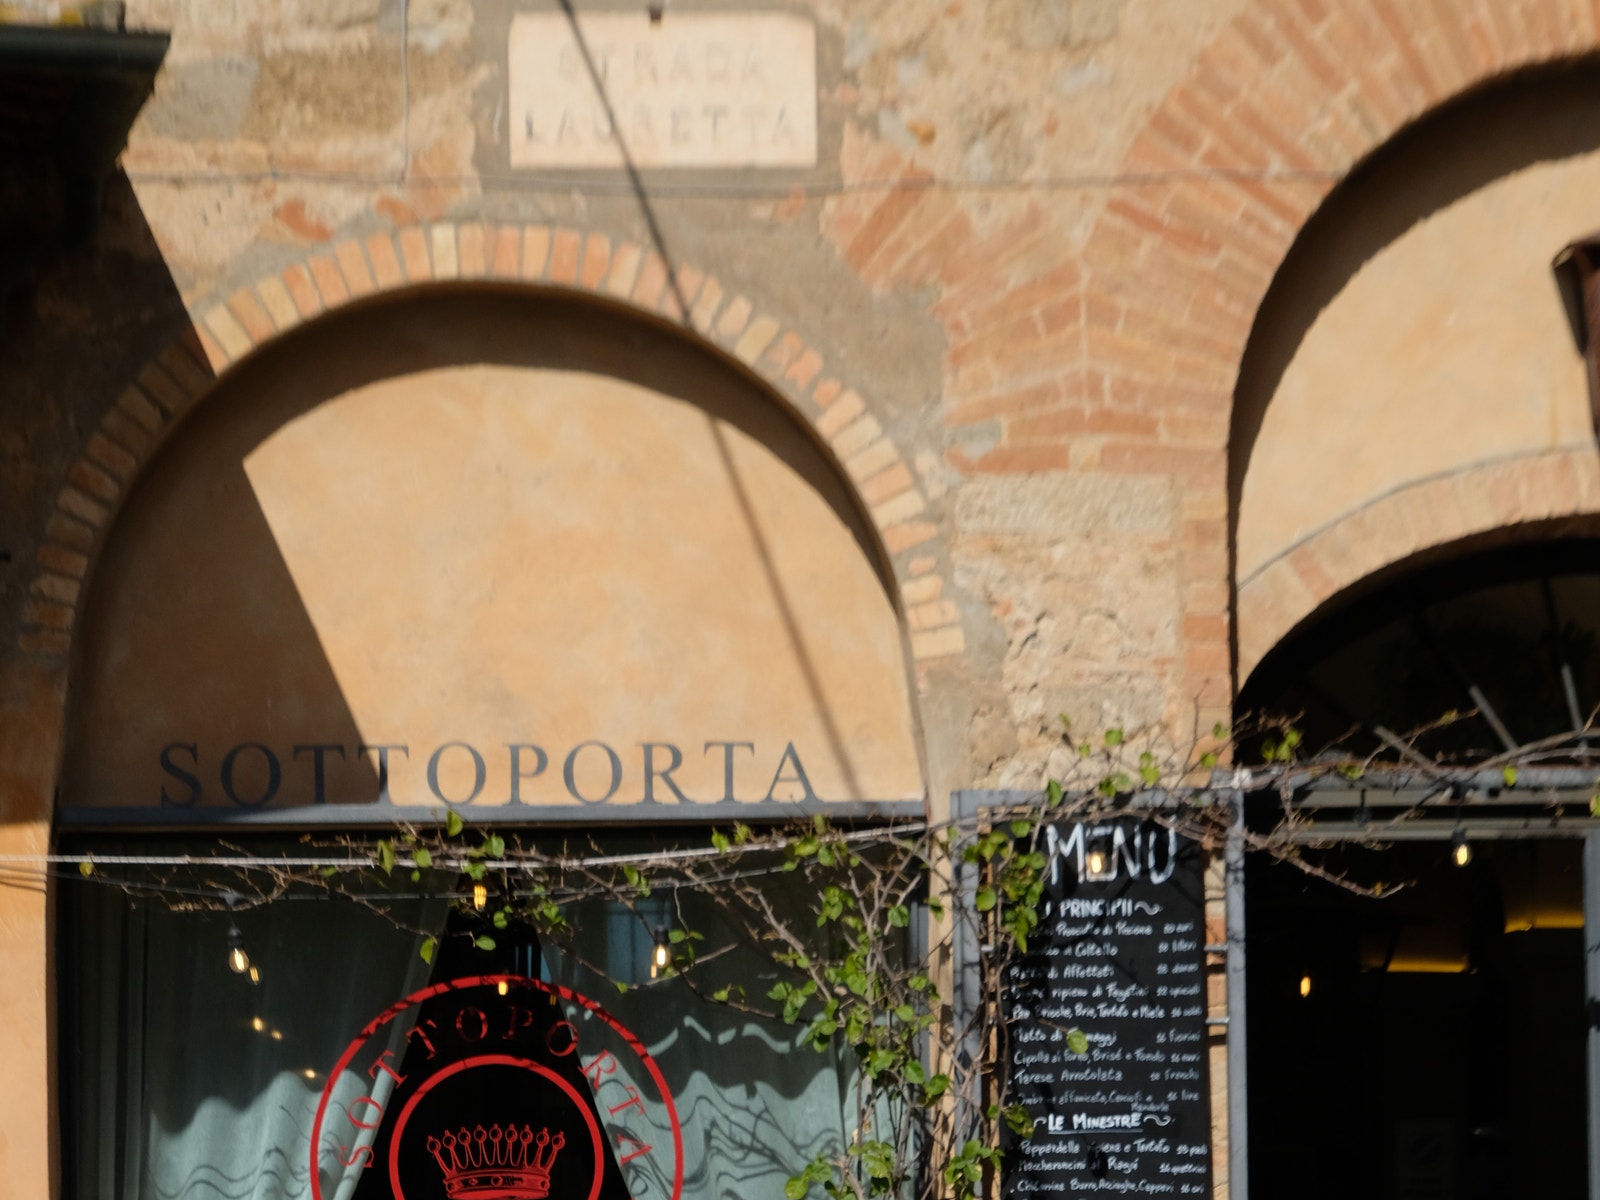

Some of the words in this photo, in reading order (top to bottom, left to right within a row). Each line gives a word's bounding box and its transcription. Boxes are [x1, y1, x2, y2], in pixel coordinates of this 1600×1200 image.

[161, 741, 819, 806] SOTTOPORTA
[1060, 898, 1133, 918] PRINCIPII
[1047, 966, 1058, 979] di
[1092, 984, 1103, 998] di
[1050, 1027, 1063, 1042] di
[1060, 1067, 1124, 1082] Arrotolata
[339, 1004, 654, 1168] SOTTOPORTA
[1048, 1113, 1065, 1131] LE
[1072, 1111, 1143, 1131] MINESTRE
